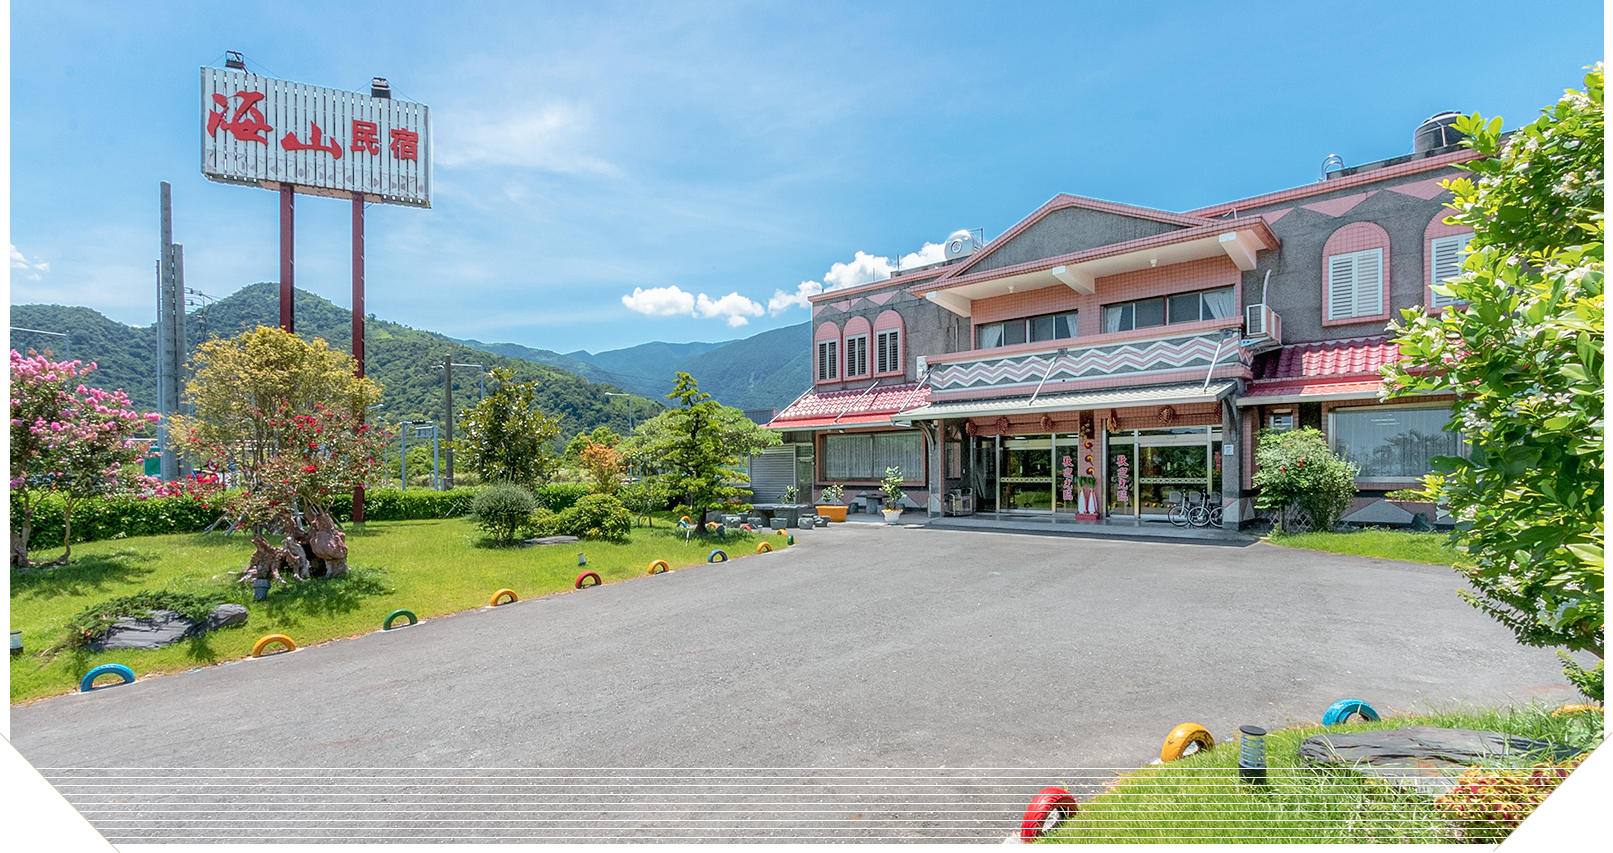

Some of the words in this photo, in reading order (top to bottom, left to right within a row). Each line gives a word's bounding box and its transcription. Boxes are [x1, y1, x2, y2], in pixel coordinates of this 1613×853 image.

[206, 90, 420, 162] 海山民宿
[1062, 455, 1074, 501] 歡迎光臨
[1116, 454, 1129, 502] 歡迎光臨
